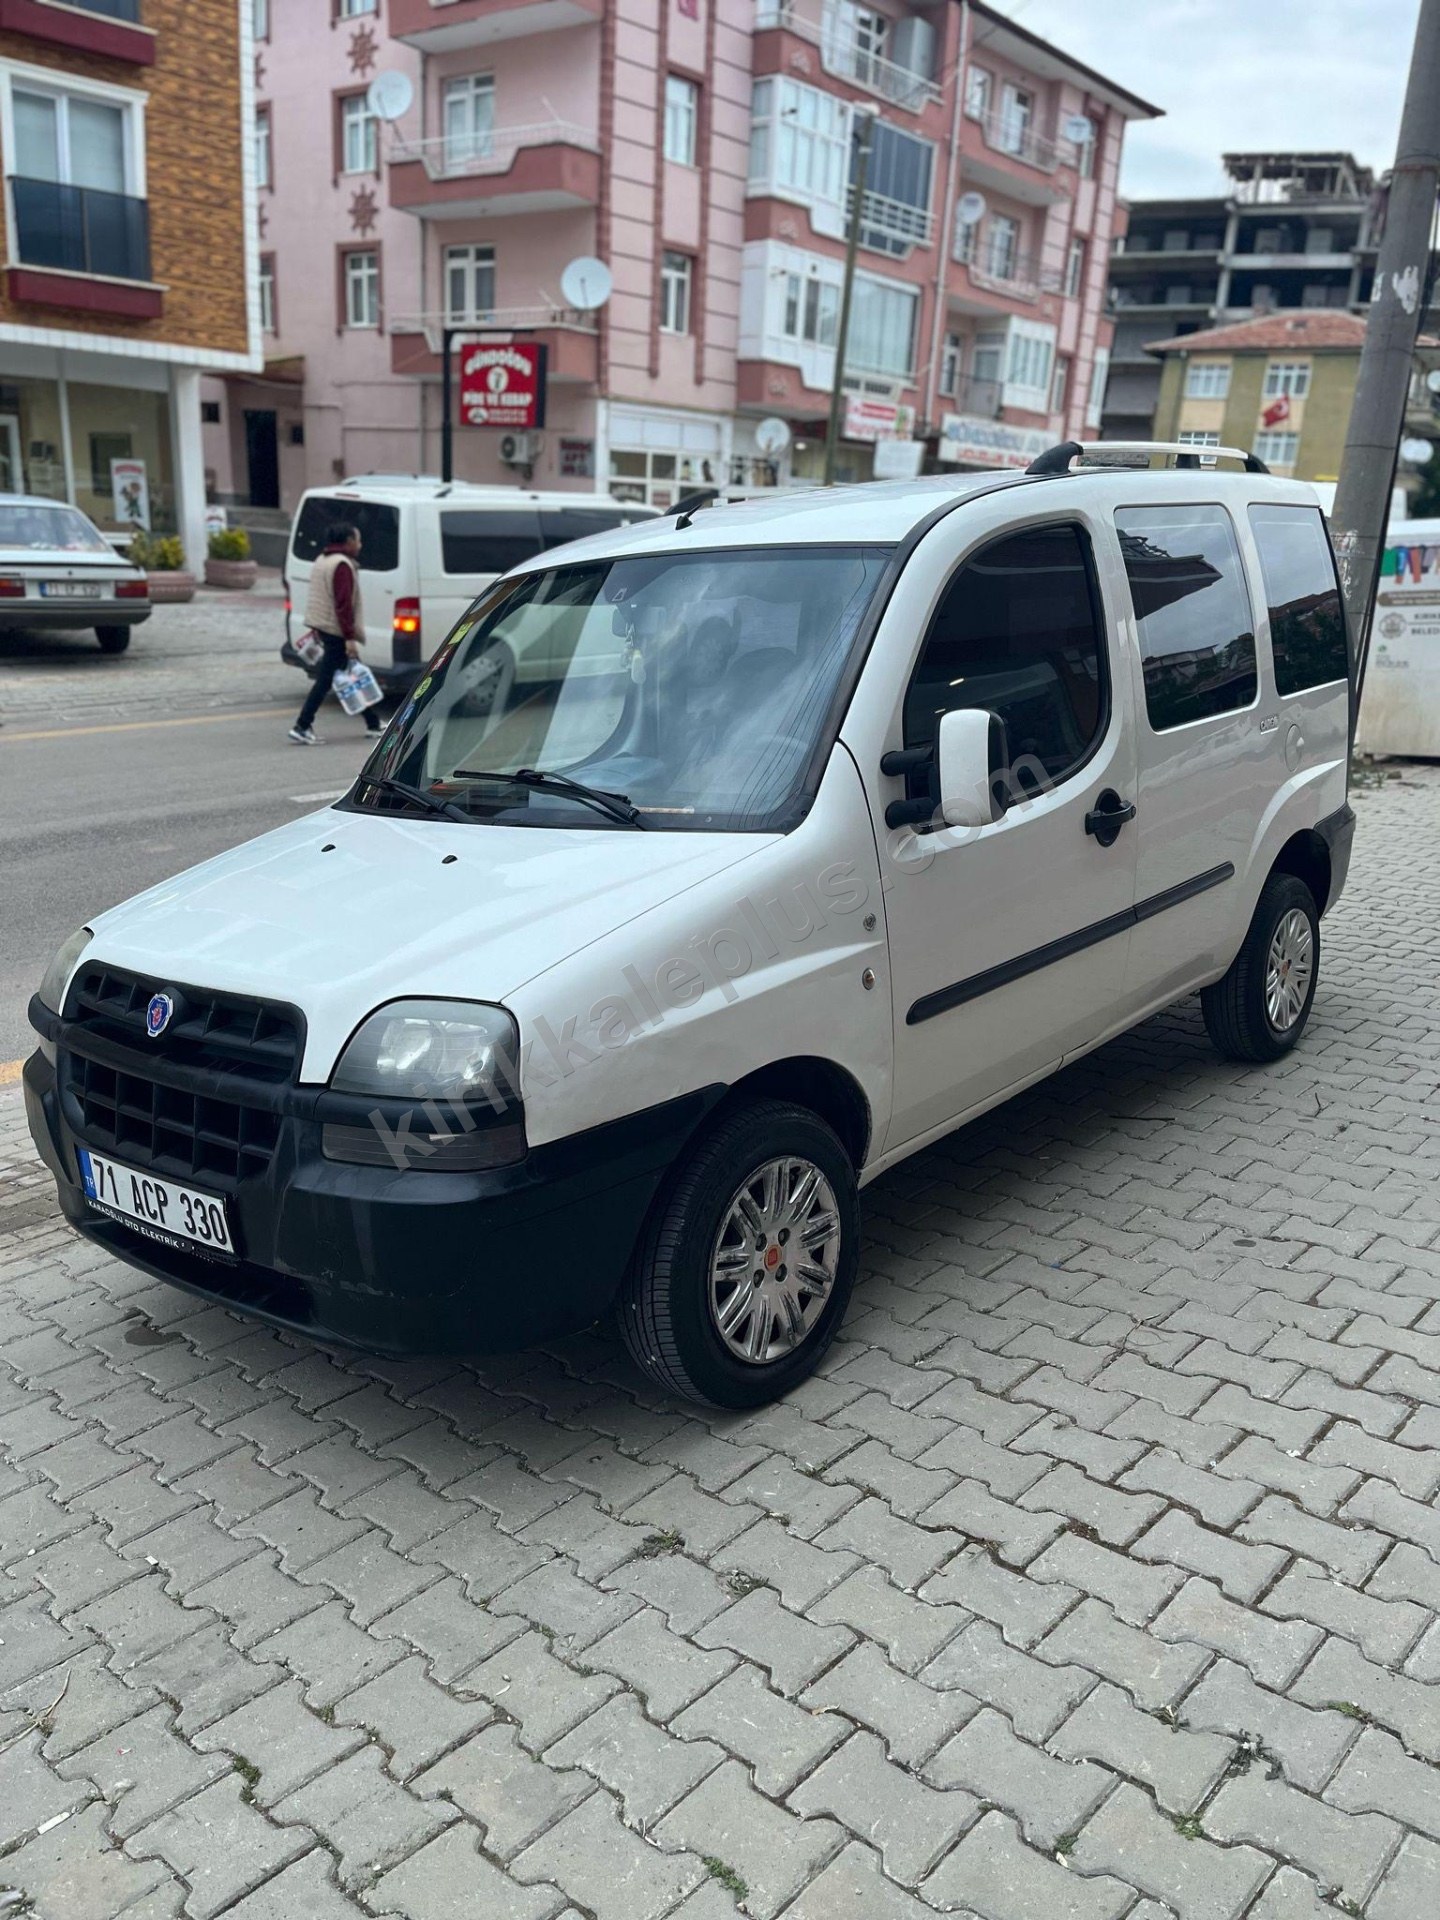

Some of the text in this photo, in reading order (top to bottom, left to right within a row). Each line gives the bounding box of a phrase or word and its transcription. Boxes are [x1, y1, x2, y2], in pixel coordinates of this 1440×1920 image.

[85, 1175, 96, 1189] TR
[93, 1158, 228, 1246] 71 ACP 330
[124, 1220, 139, 1232] OTO
[141, 1226, 180, 1249] ELEKTRİK
